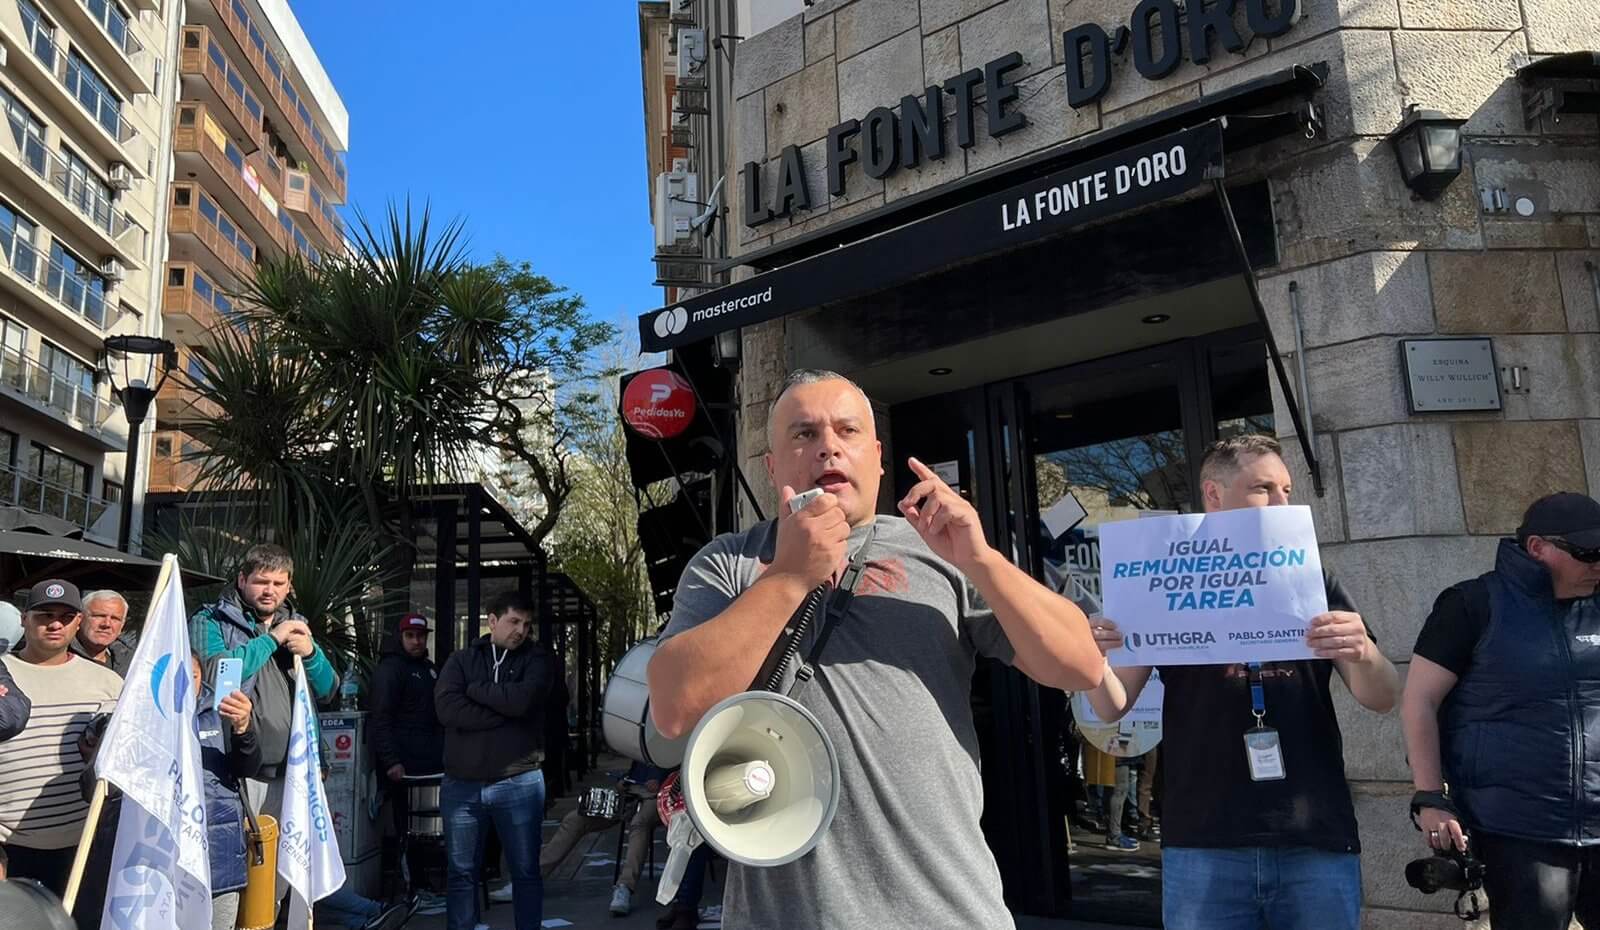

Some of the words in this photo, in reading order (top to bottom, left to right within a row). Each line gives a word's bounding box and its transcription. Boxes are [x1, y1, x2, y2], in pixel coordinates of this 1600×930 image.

[744, 144, 812, 227] LA
[827, 51, 1027, 197] FONTE
[1002, 198, 1031, 231] LA
[1034, 171, 1108, 221] FONTE
[1115, 145, 1187, 195] D'ORO
[692, 287, 772, 322] mastercard
[634, 407, 685, 418] PedidosYa
[1064, 542, 1101, 570] FON
[1168, 537, 1234, 556] IGUAL
[1113, 546, 1305, 578] REMUNERACIÓN
[1149, 576, 1194, 592] POR
[1200, 570, 1267, 589] IGUAL
[1166, 588, 1254, 611] TAREA
[1145, 631, 1216, 646] UTHGRA
[1229, 630, 1264, 641] PABLO
